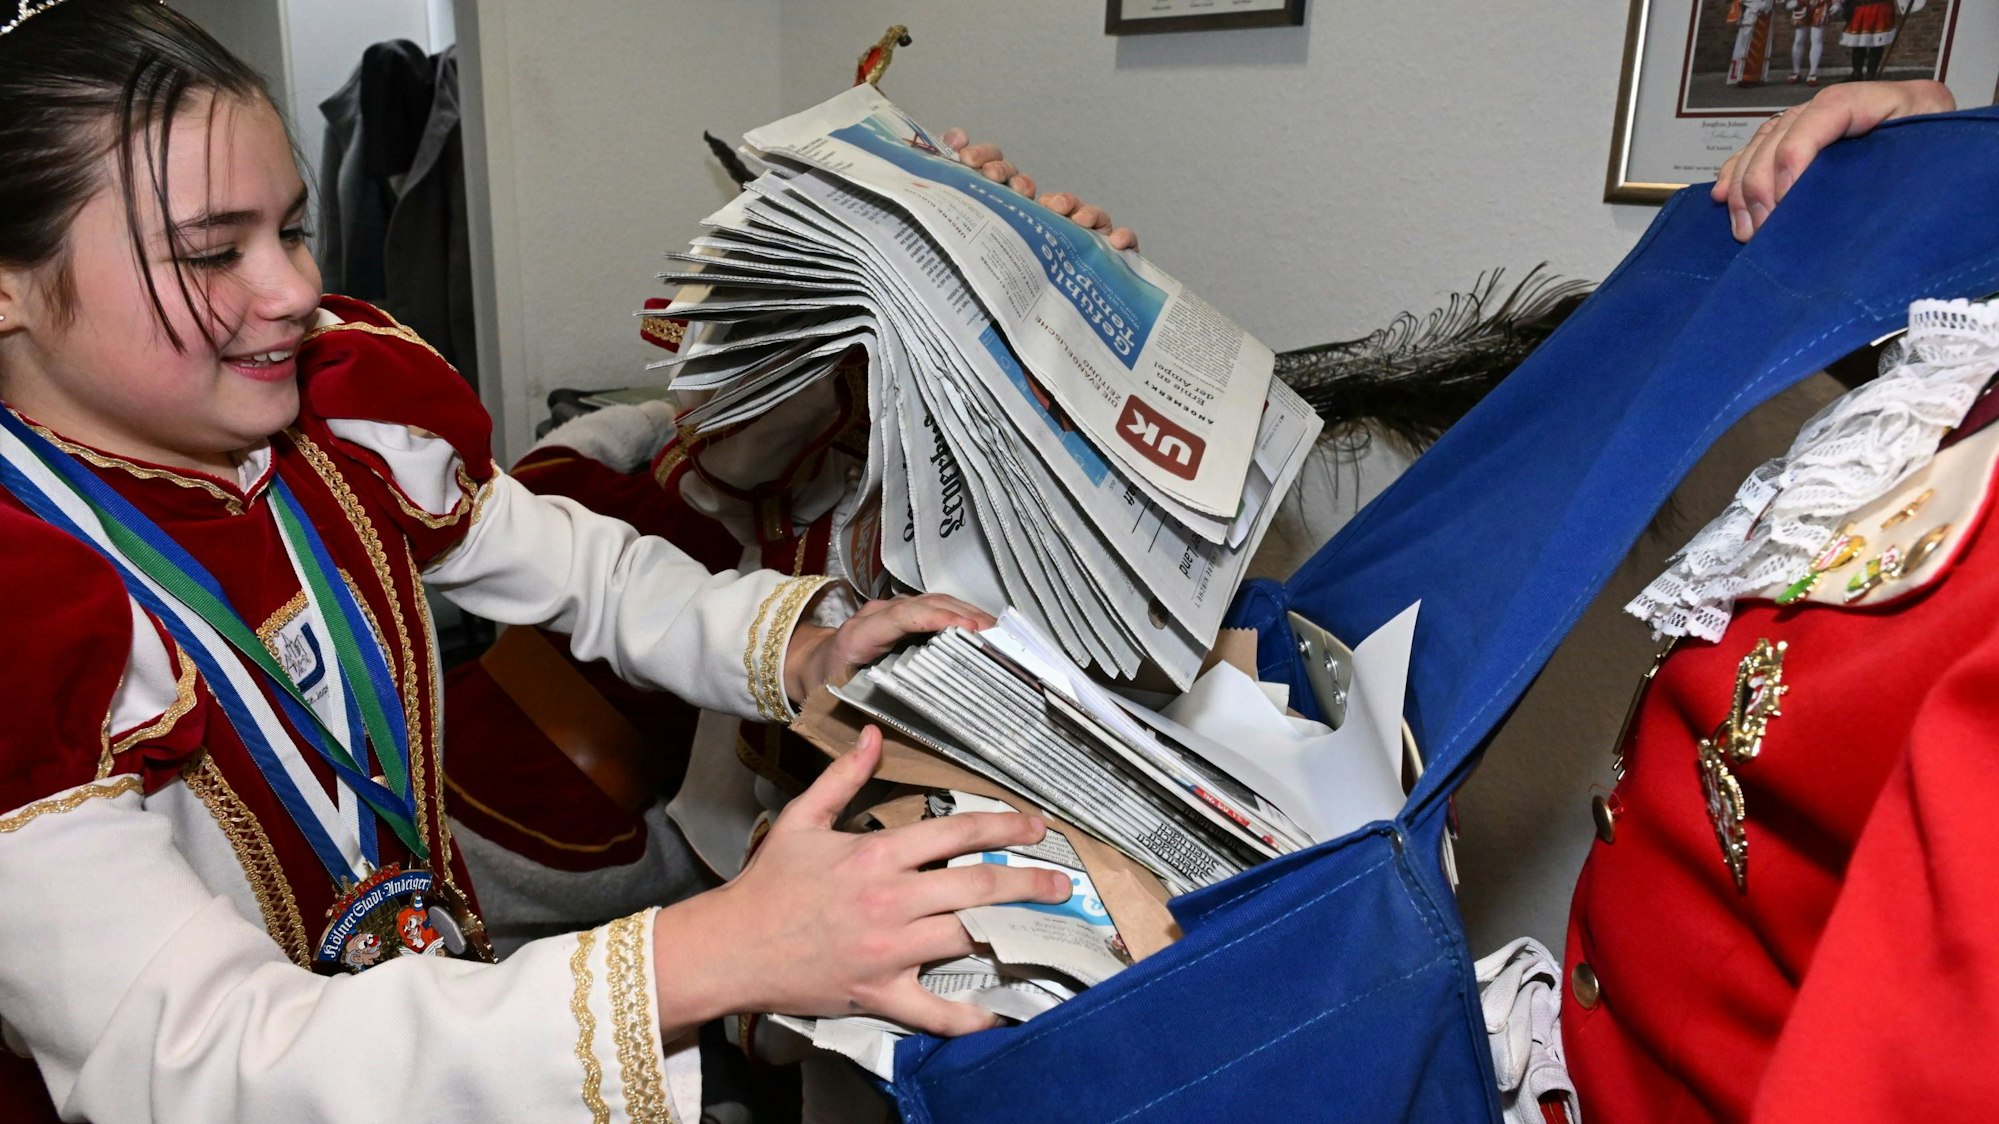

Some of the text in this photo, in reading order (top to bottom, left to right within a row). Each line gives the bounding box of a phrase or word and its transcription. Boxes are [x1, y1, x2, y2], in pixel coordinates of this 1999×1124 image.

[969, 181, 1135, 346] Temperaturen
[1037, 242, 1131, 354] Gefühlte
[1032, 314, 1118, 407] DIE EVANGELISCHE
[1080, 358, 1122, 400] ZEITUNG
[1152, 360, 1214, 400] der Ampel
[1143, 378, 1214, 425] ANGEMERKT
[1155, 371, 1206, 406] Ernie an
[1123, 408, 1191, 464] UK
[1178, 544, 1199, 580] Land
[324, 912, 357, 958] Kölner
